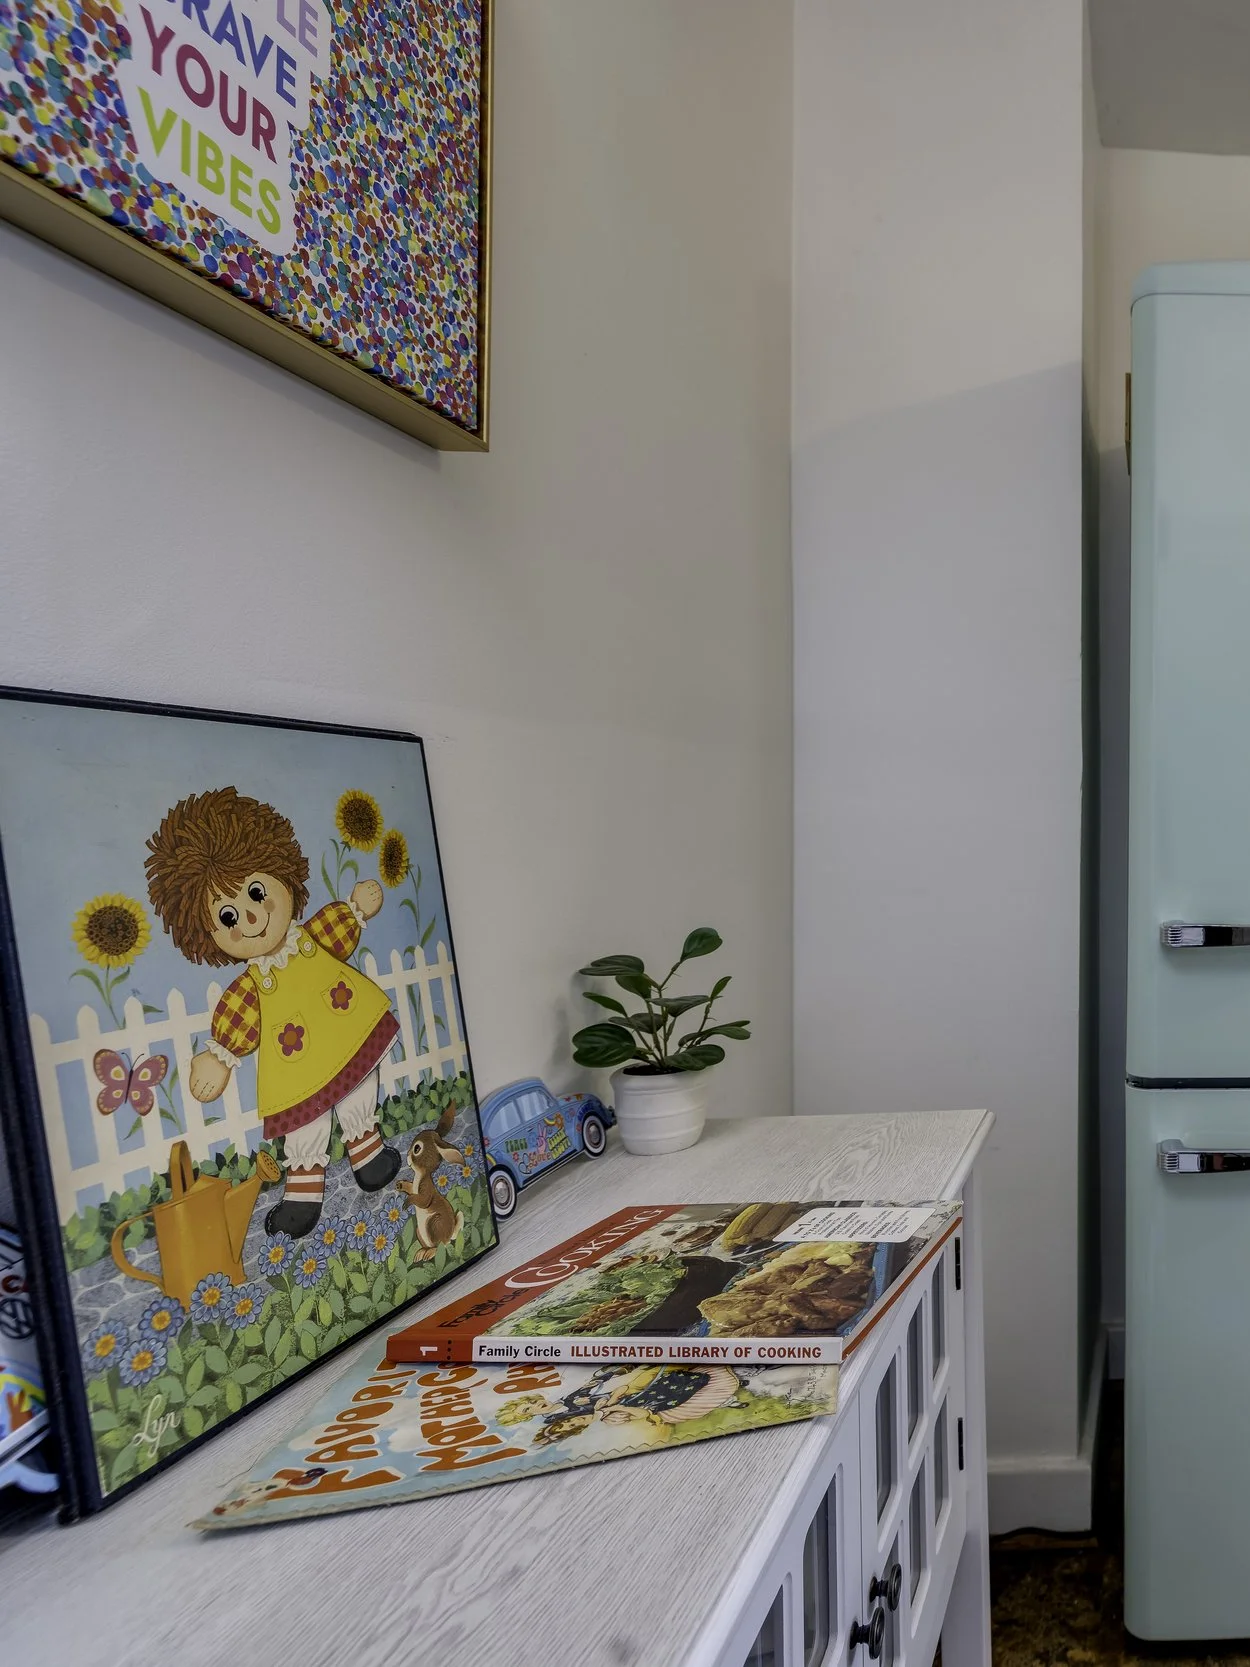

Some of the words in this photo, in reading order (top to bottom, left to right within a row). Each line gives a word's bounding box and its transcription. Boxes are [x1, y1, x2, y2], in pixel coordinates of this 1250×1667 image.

[140, 4, 278, 164] YOUR
[137, 86, 281, 235] VIBES
[478, 1345, 520, 1359] Family
[524, 1345, 561, 1357] Circle
[571, 1345, 664, 1358] ILLUSTRATED
[669, 1346, 730, 1358] LIBRARY
[734, 1347, 752, 1358] OF
[758, 1347, 822, 1358] COOKING
